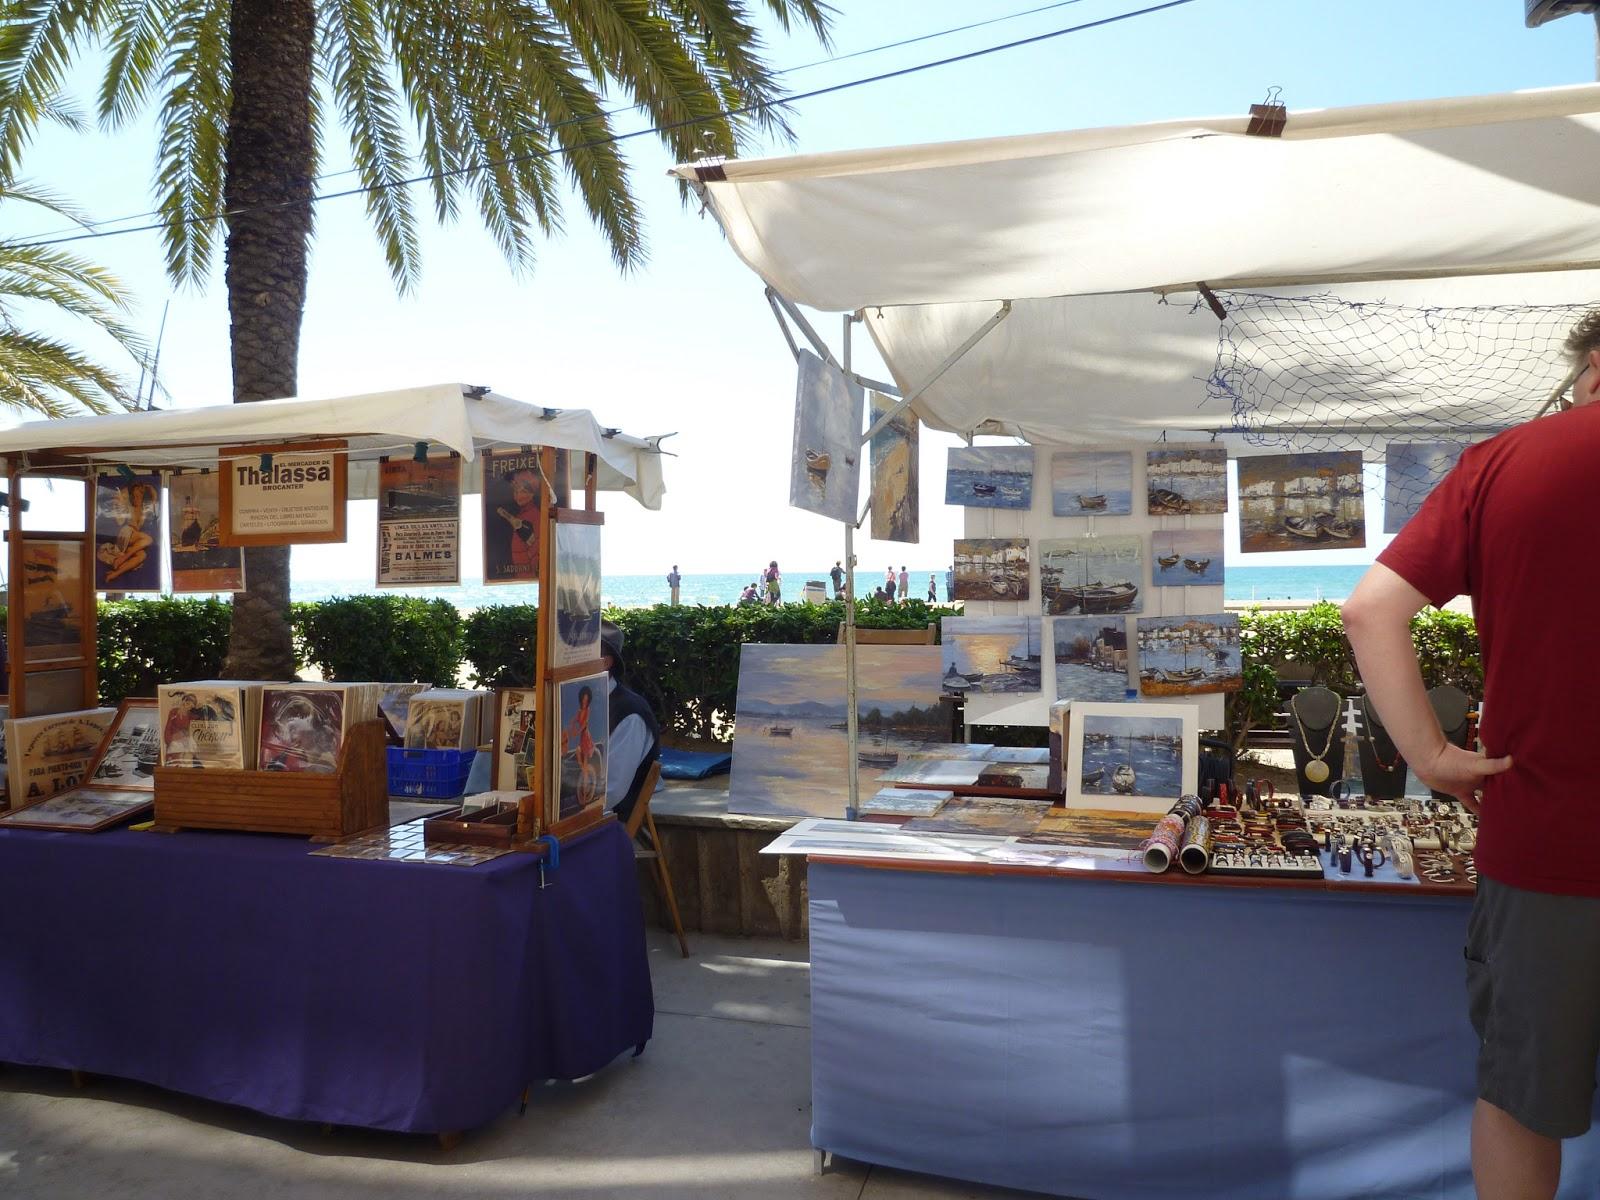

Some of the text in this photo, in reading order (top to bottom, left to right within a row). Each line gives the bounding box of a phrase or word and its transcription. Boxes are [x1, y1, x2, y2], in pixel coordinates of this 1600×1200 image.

[236, 464, 331, 486] Thalassa
[262, 483, 304, 491] BROCANTER
[395, 550, 452, 561] BALMES
[27, 782, 46, 798] A.
